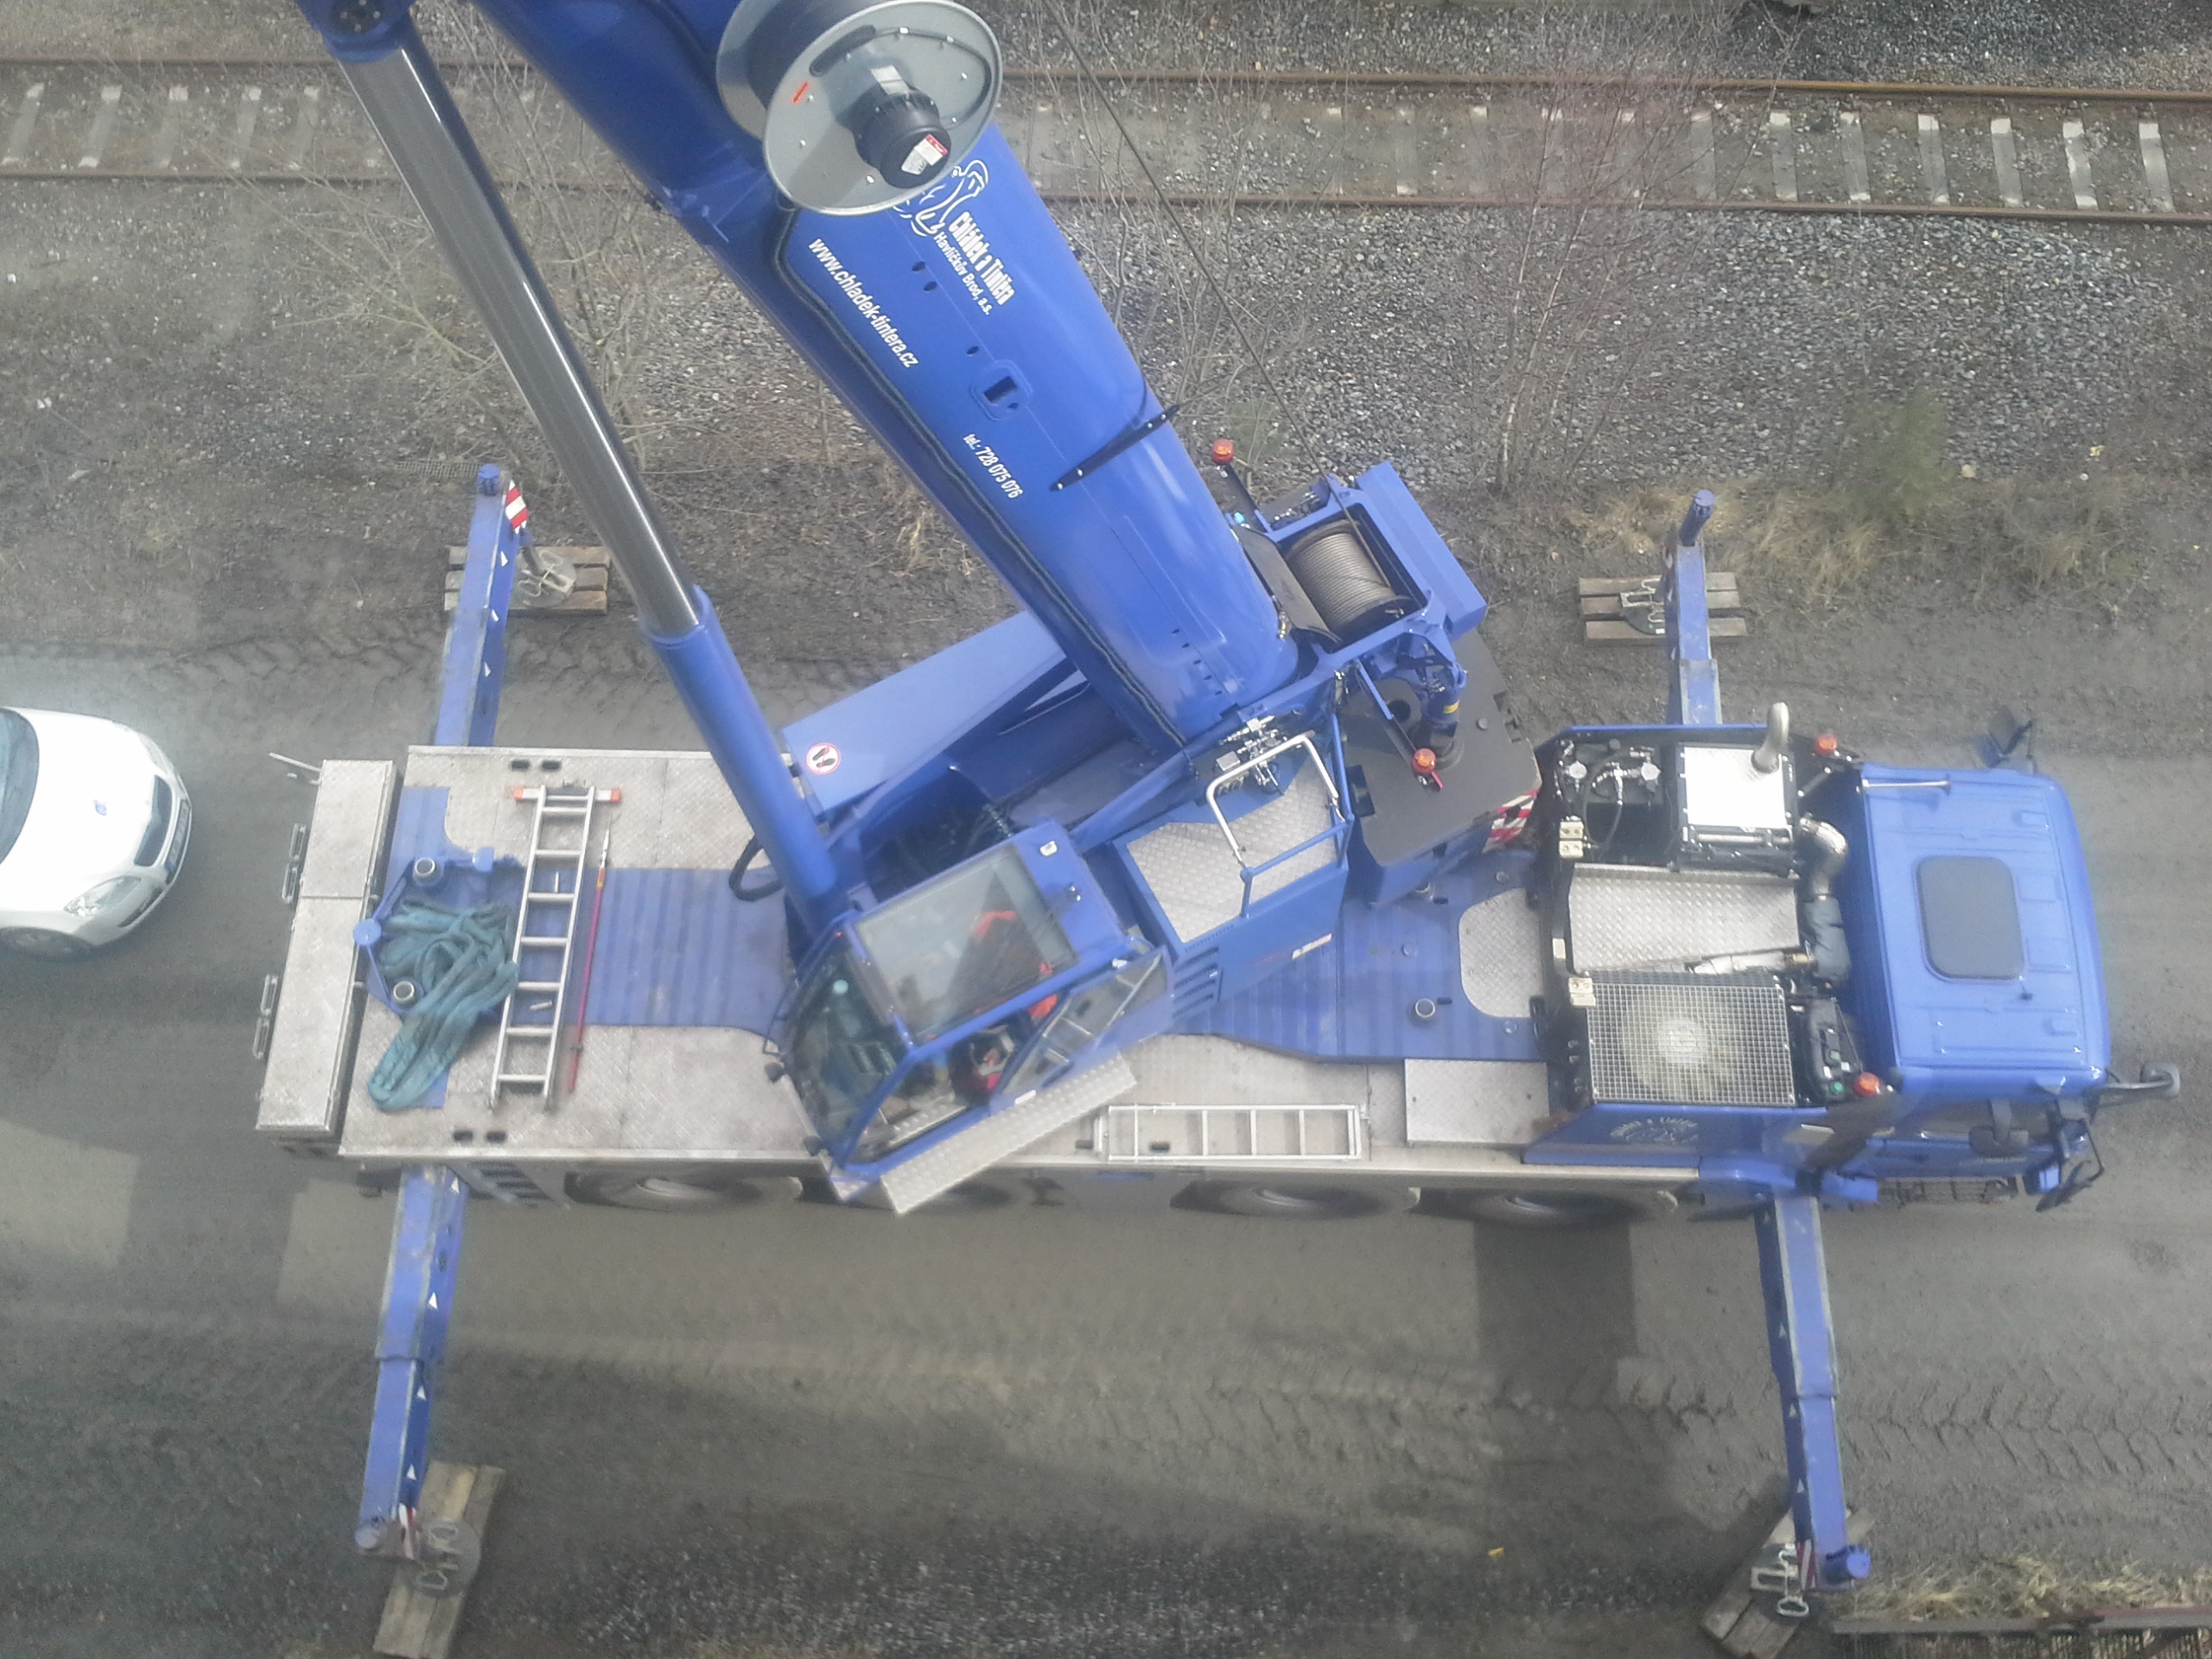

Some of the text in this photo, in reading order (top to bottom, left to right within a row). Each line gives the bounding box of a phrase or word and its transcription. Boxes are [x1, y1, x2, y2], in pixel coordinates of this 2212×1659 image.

[949, 212, 1014, 305] Chládek a Tintěra
[963, 273, 984, 300] Brod,
[977, 297, 993, 315] a.s.
[808, 238, 918, 367] www.chladek-tintera.cz
[975, 446, 999, 467] 728
[988, 463, 1012, 483] 075
[1001, 480, 1023, 499] 076
